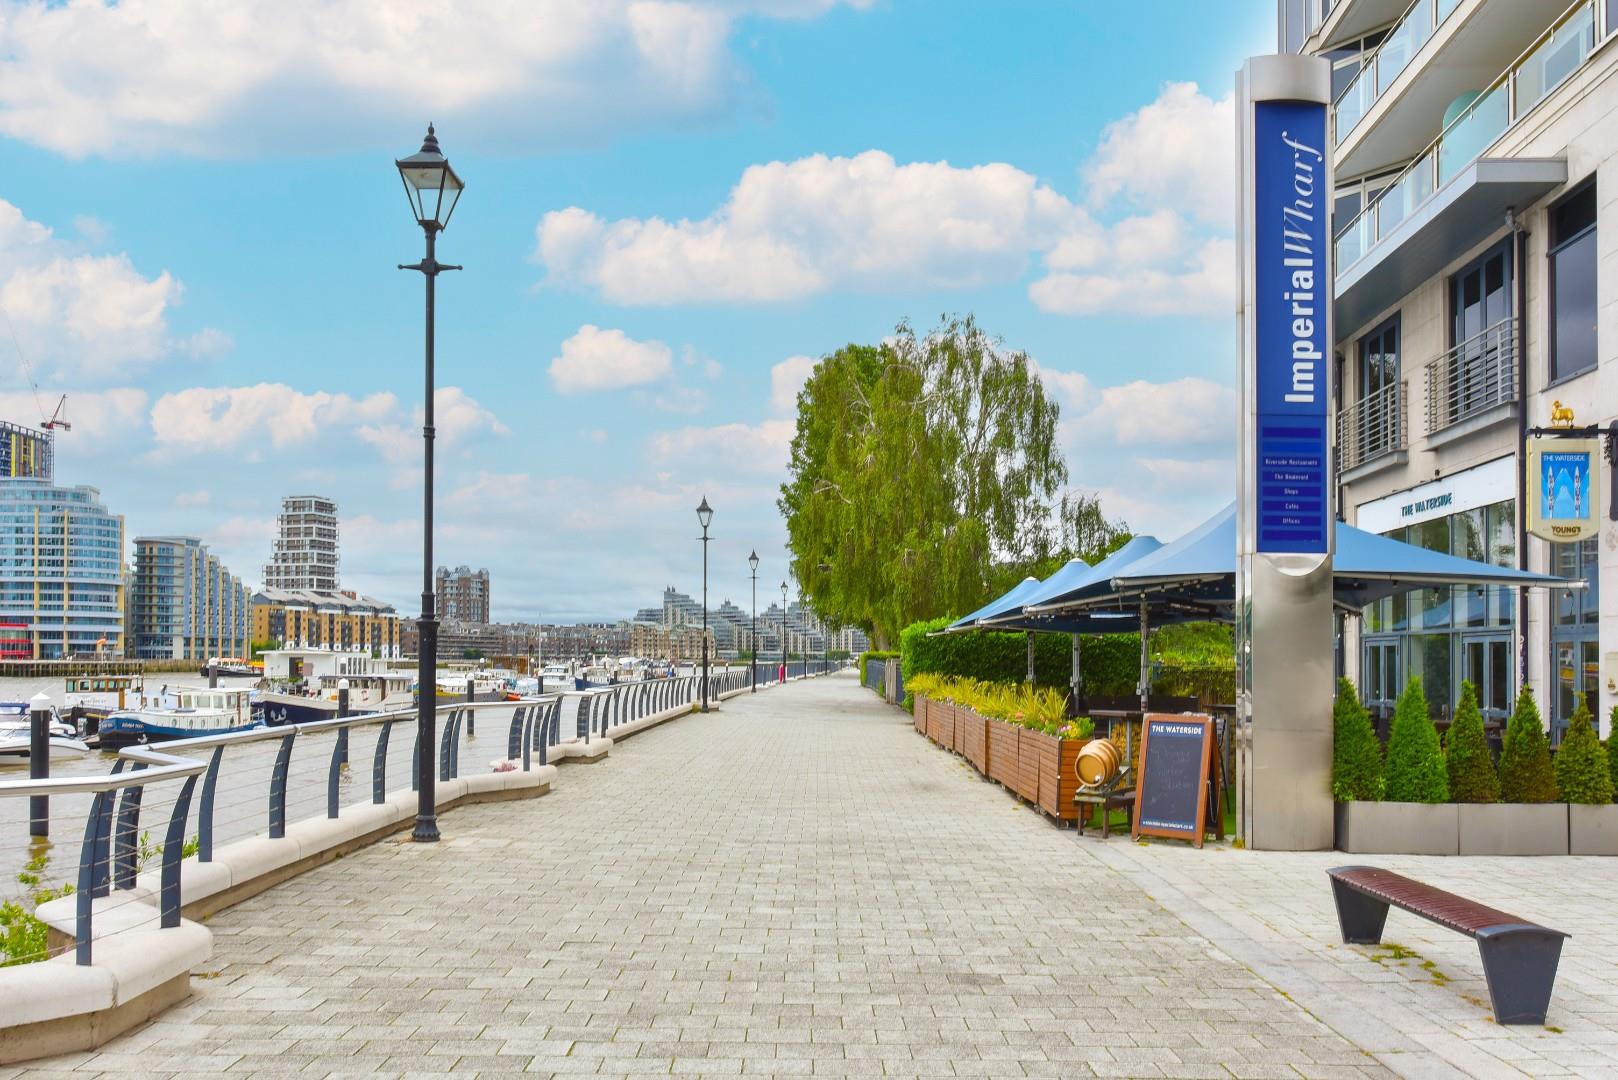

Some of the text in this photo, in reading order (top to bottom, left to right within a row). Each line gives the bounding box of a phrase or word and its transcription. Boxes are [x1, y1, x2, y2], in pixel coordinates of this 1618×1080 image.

[1289, 458, 1318, 466] Restaurants
[1543, 454, 1585, 462] THE WATERSIDE
[1401, 492, 1453, 518] THE WATERSIDE
[1152, 724, 1203, 735] THE WATERSIDE
